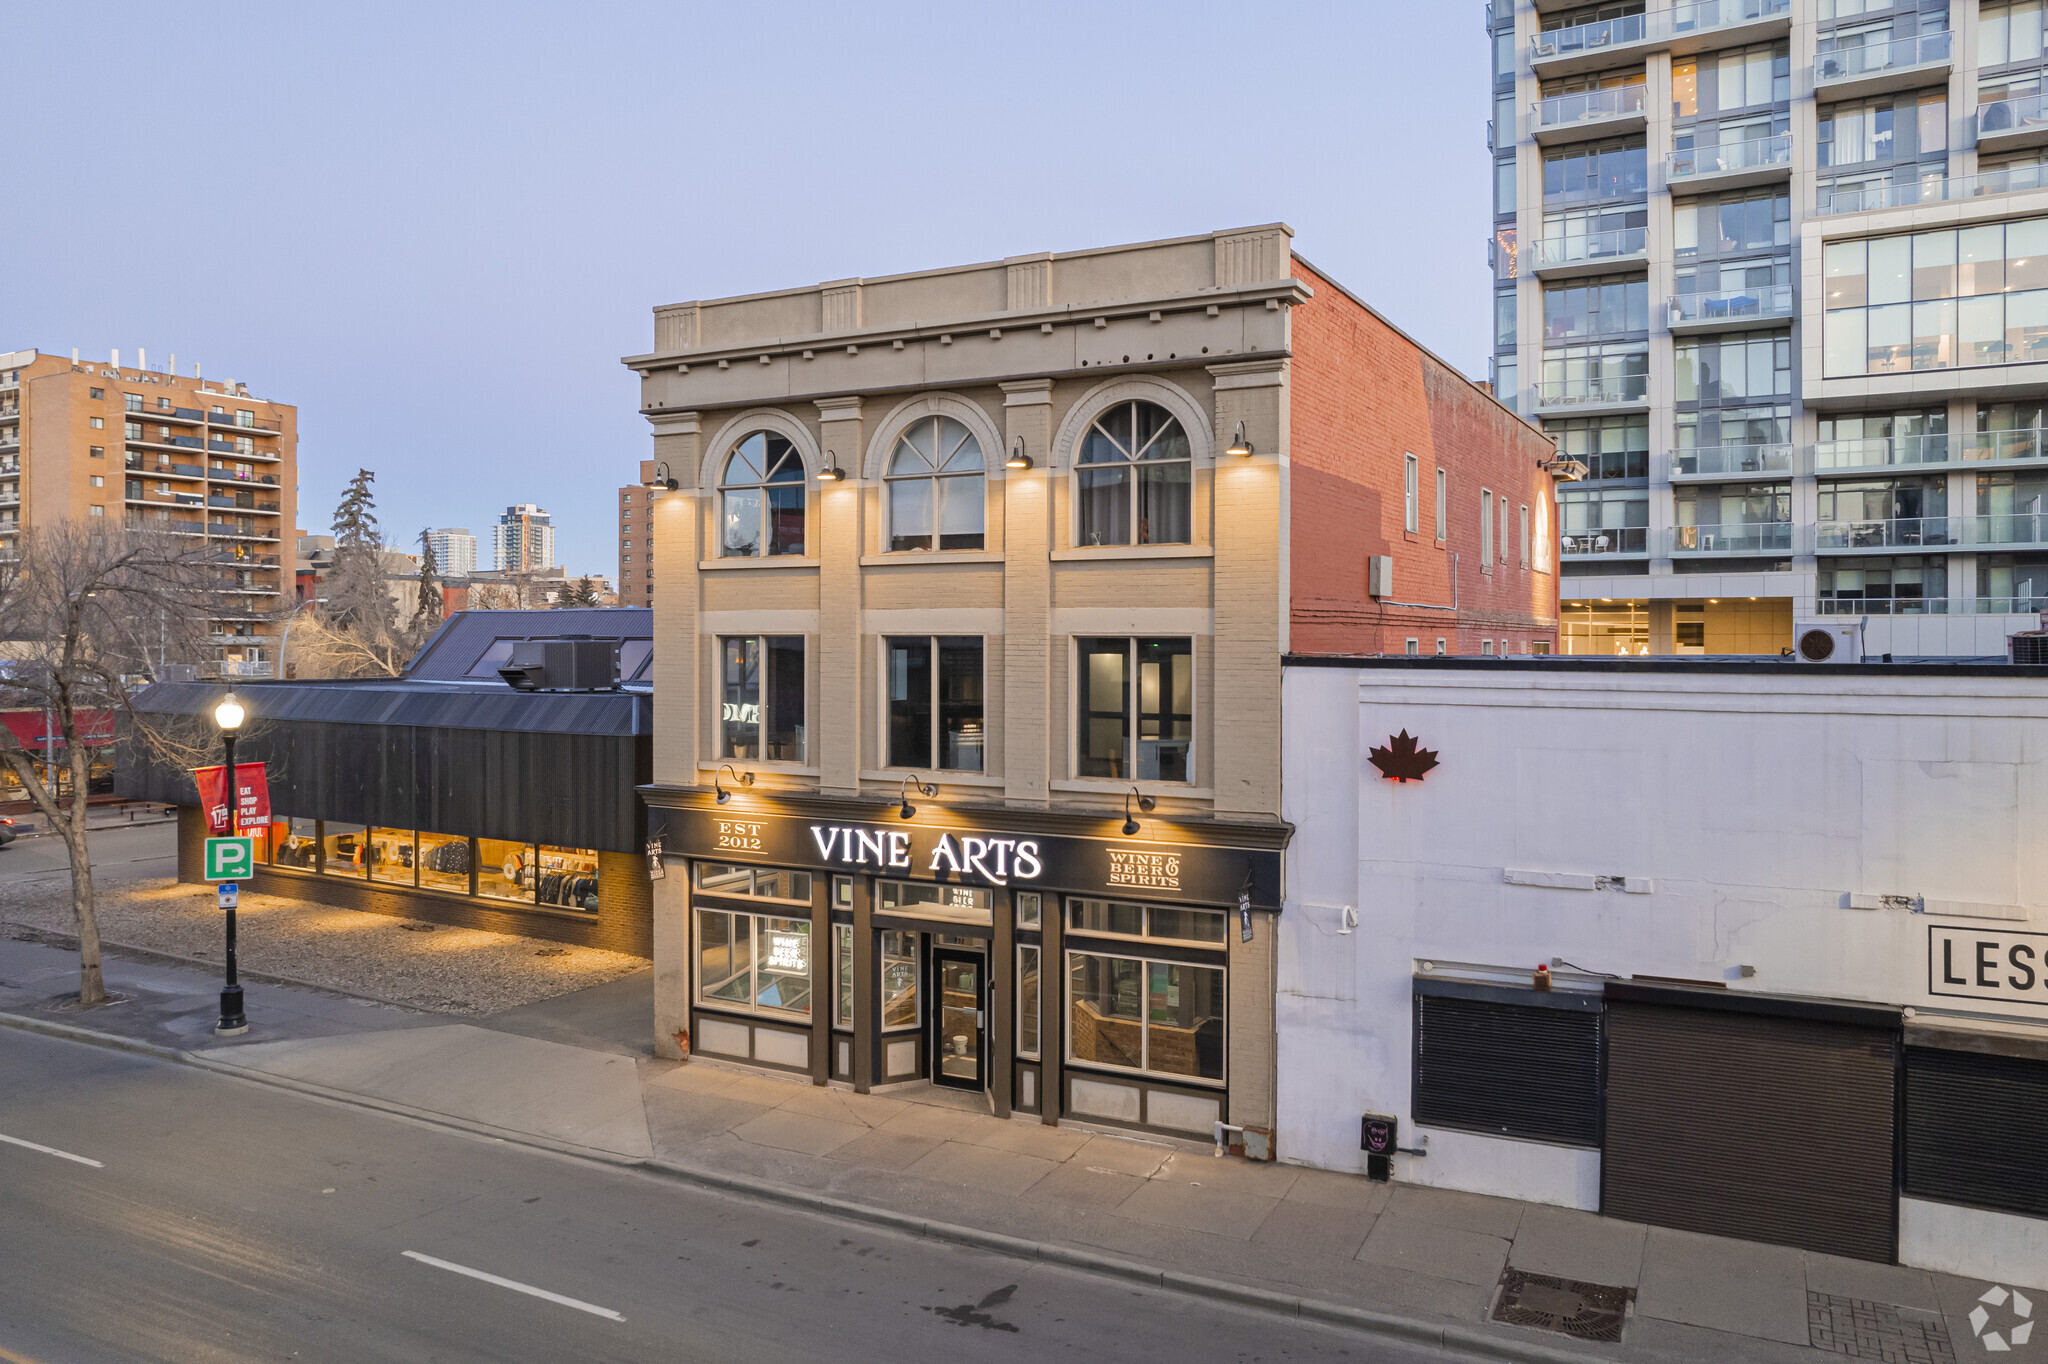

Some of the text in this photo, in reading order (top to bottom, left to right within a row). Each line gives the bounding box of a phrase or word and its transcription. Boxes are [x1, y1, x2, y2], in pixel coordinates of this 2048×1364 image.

[240, 786, 251, 796] EAT
[240, 796, 257, 806] SHOP
[240, 807, 256, 816] PLAY
[240, 815, 269, 826] EXPLORE
[719, 822, 761, 836] EST
[646, 841, 662, 849] VINE
[719, 835, 761, 849] 2012
[216, 843, 245, 872] P
[647, 848, 662, 856] ARTS
[810, 825, 1042, 886] VINE ARTS
[1110, 853, 1180, 877] WINE &
[1110, 862, 1163, 876] BEER
[1110, 873, 1179, 888] SPIRITS
[1943, 938, 2048, 990] LES
